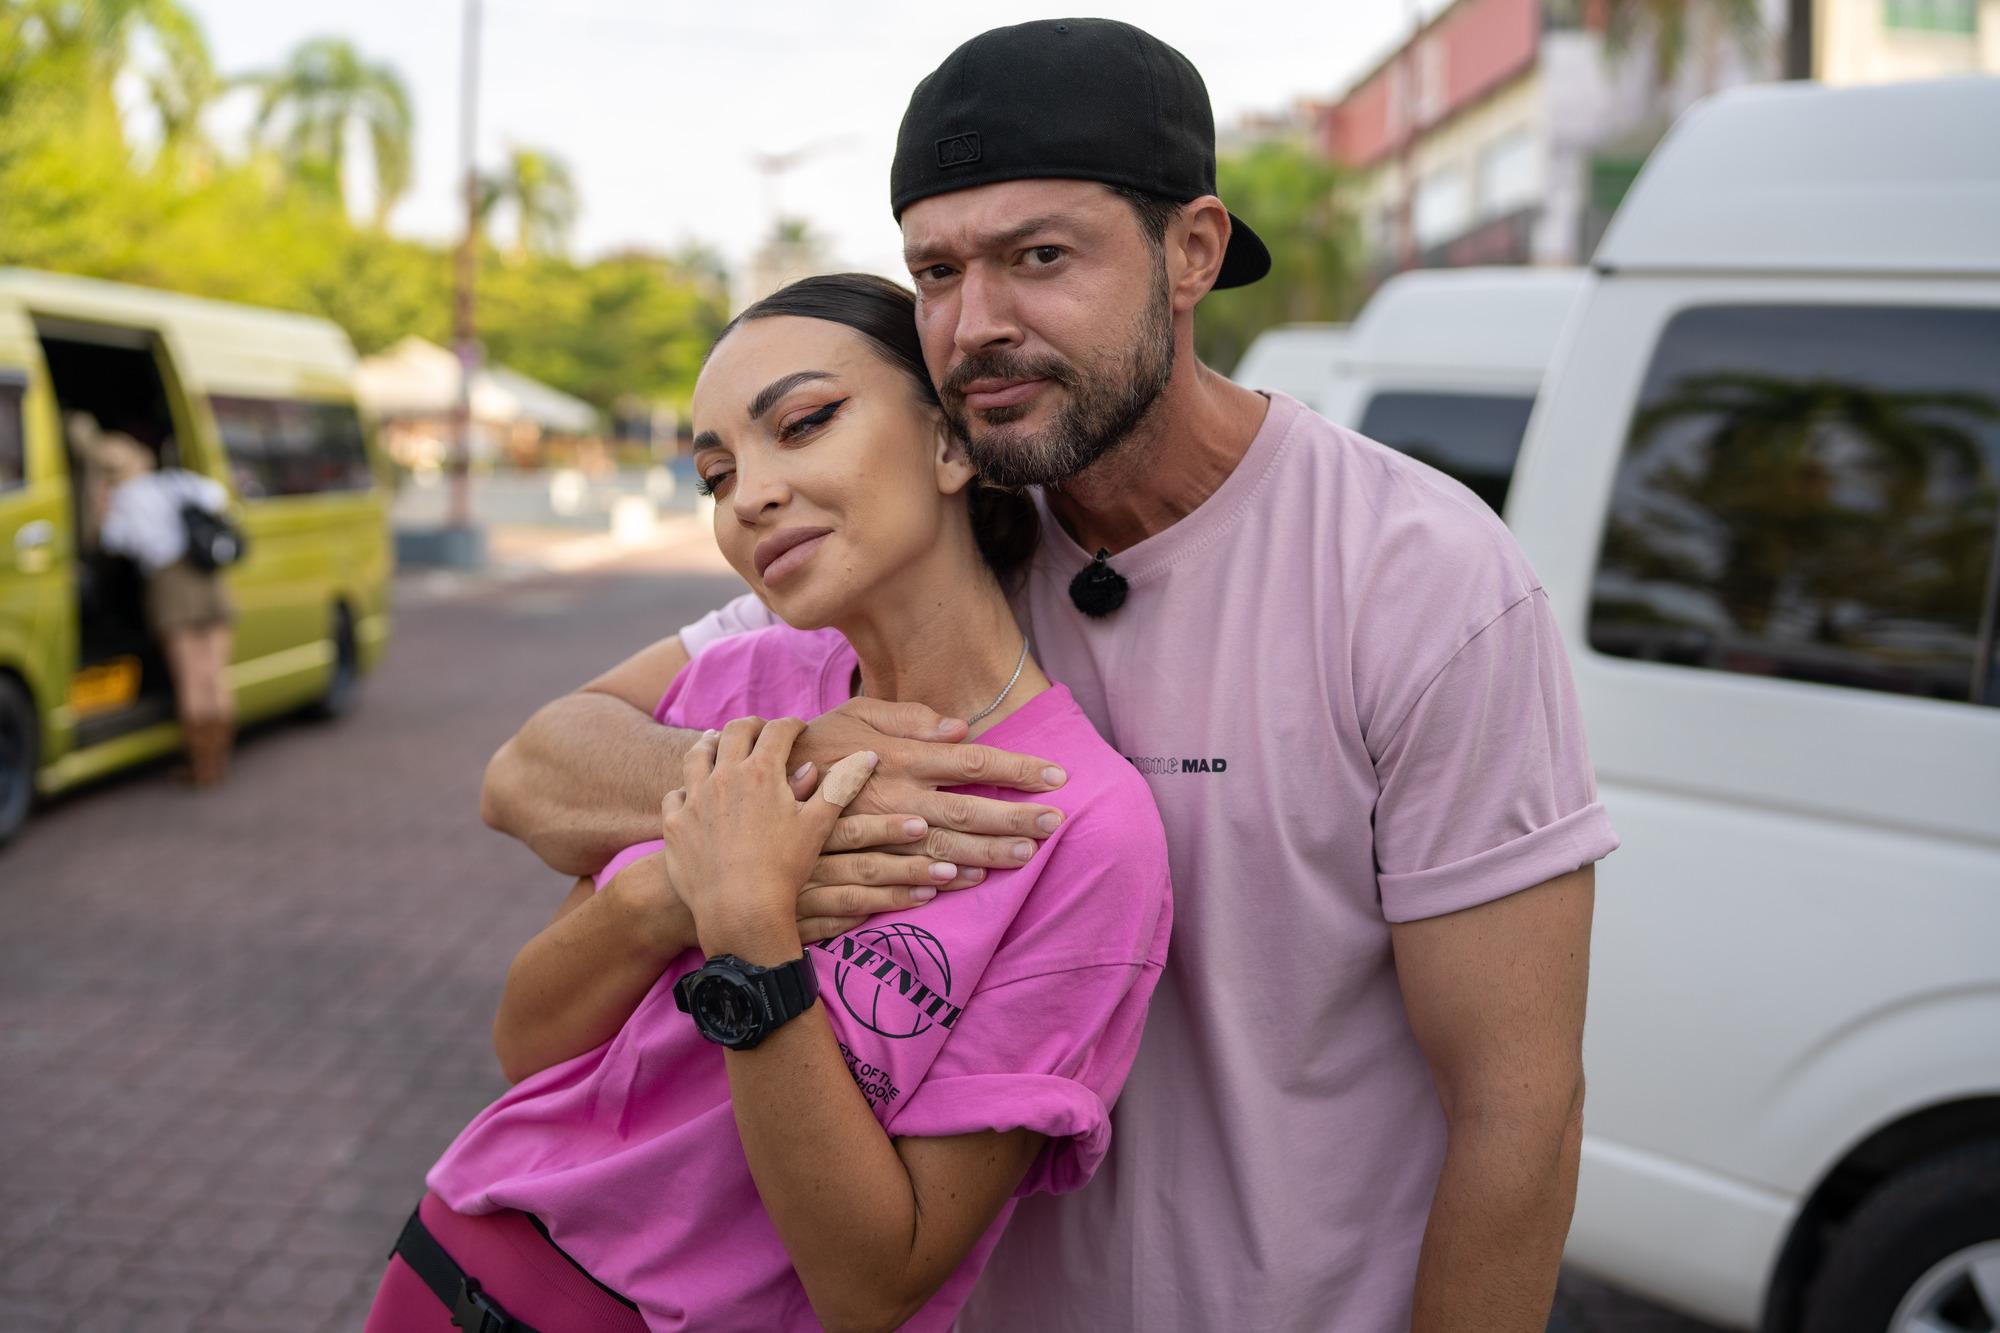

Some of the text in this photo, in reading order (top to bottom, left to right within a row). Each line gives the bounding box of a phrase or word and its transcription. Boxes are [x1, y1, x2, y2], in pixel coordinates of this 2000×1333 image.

[1182, 758, 1227, 773] MAD
[861, 1063, 880, 1079] OF
[879, 1071, 900, 1101] THE
